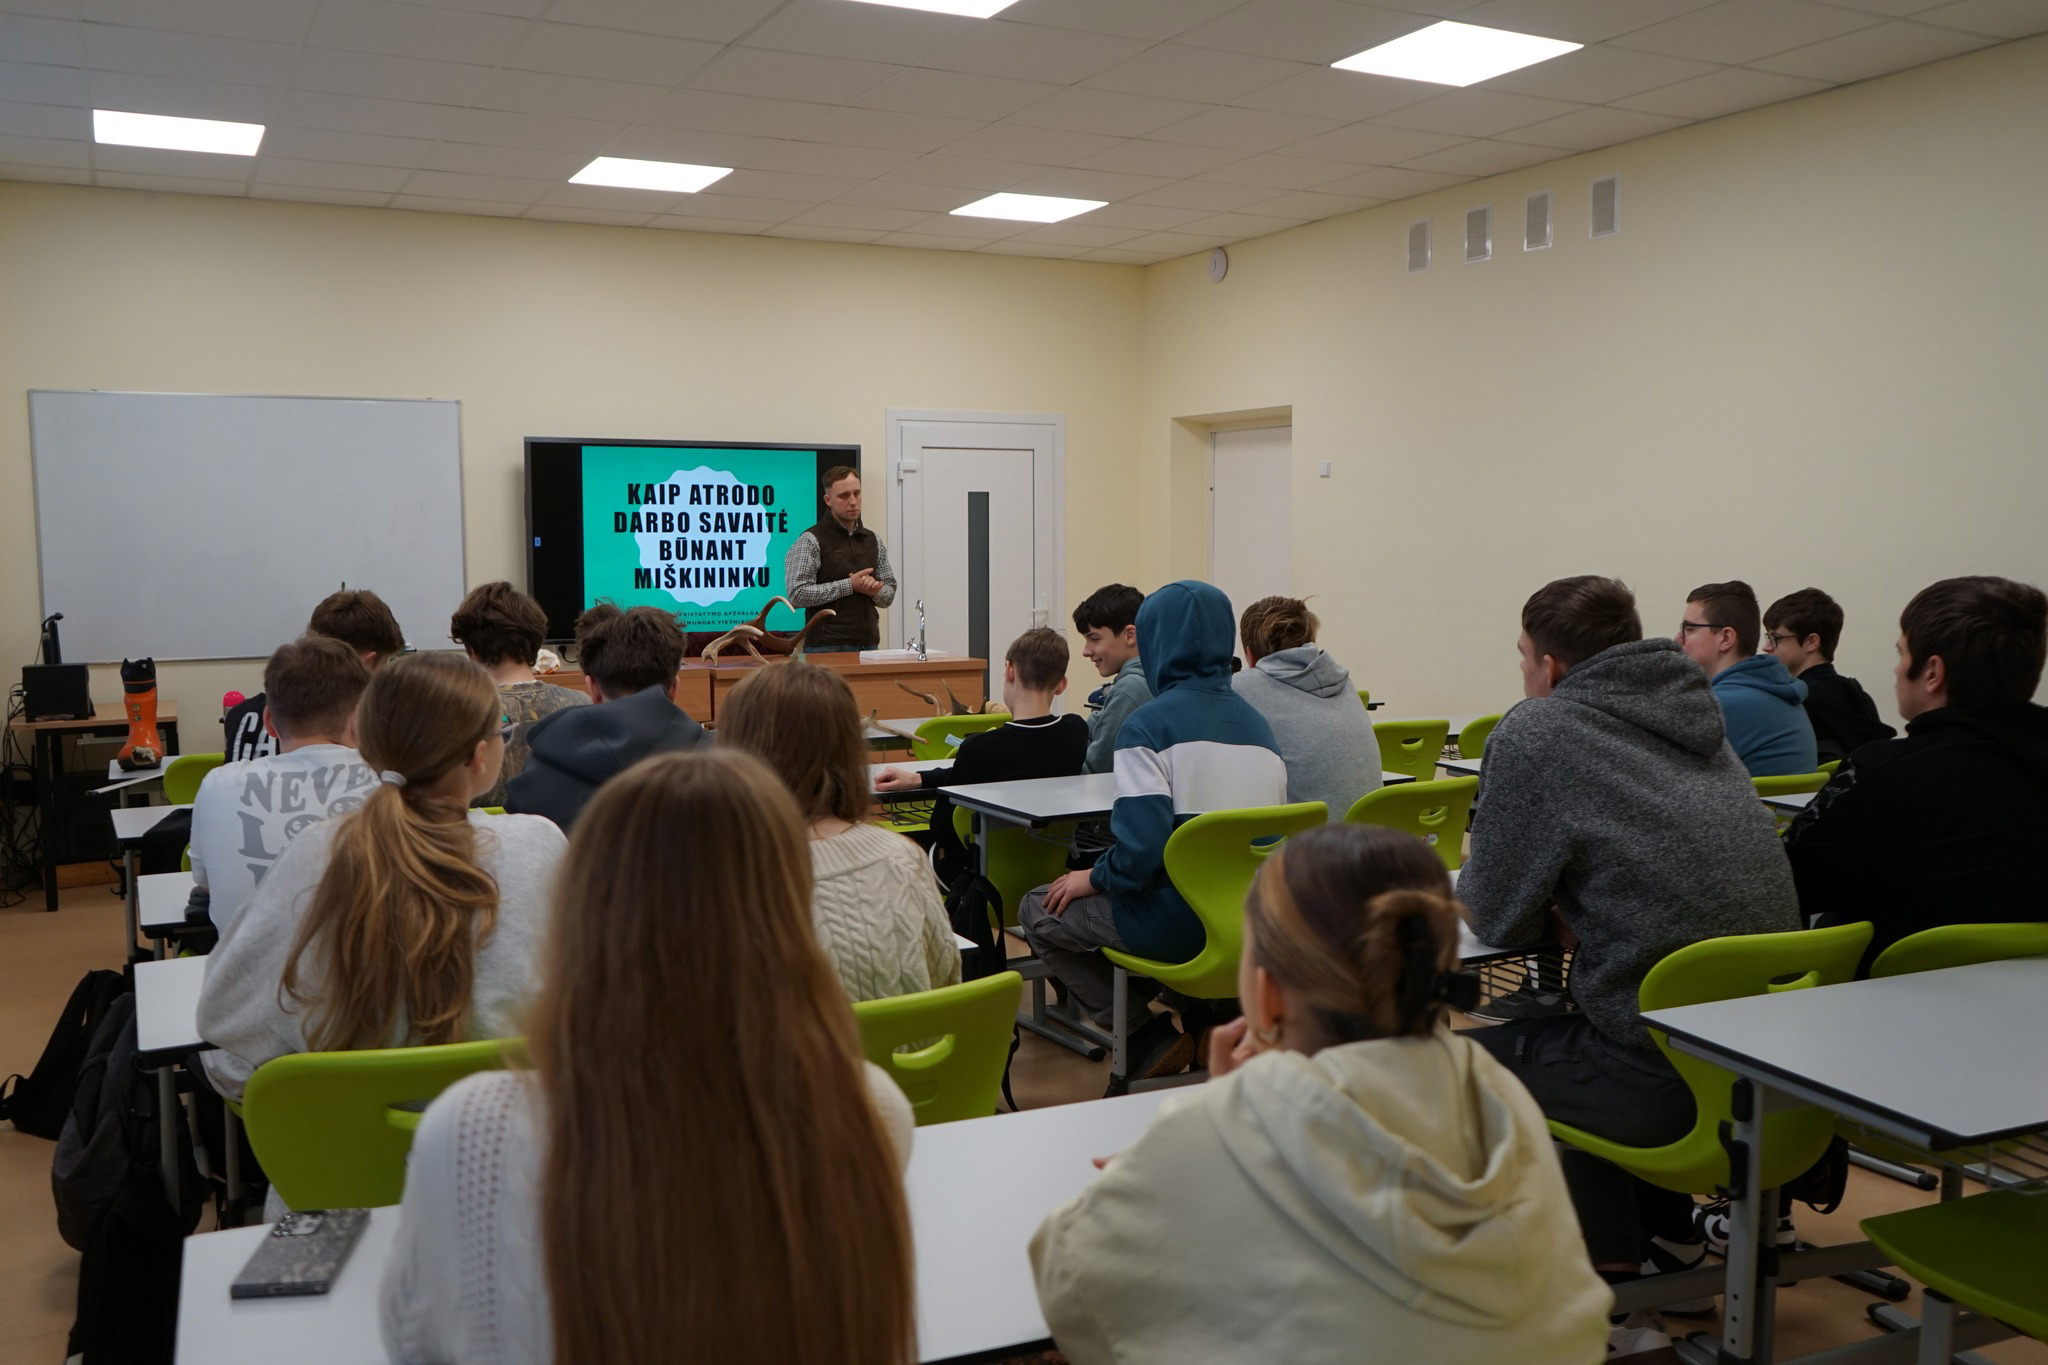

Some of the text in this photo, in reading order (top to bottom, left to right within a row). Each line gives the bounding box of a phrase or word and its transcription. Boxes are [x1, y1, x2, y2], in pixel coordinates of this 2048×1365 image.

[628, 483, 775, 506] KAIP ATRODO
[614, 509, 788, 533] DARBO SAVAITĖ
[659, 537, 747, 561] BŪNANT
[634, 563, 770, 589] MIŠKININKU
